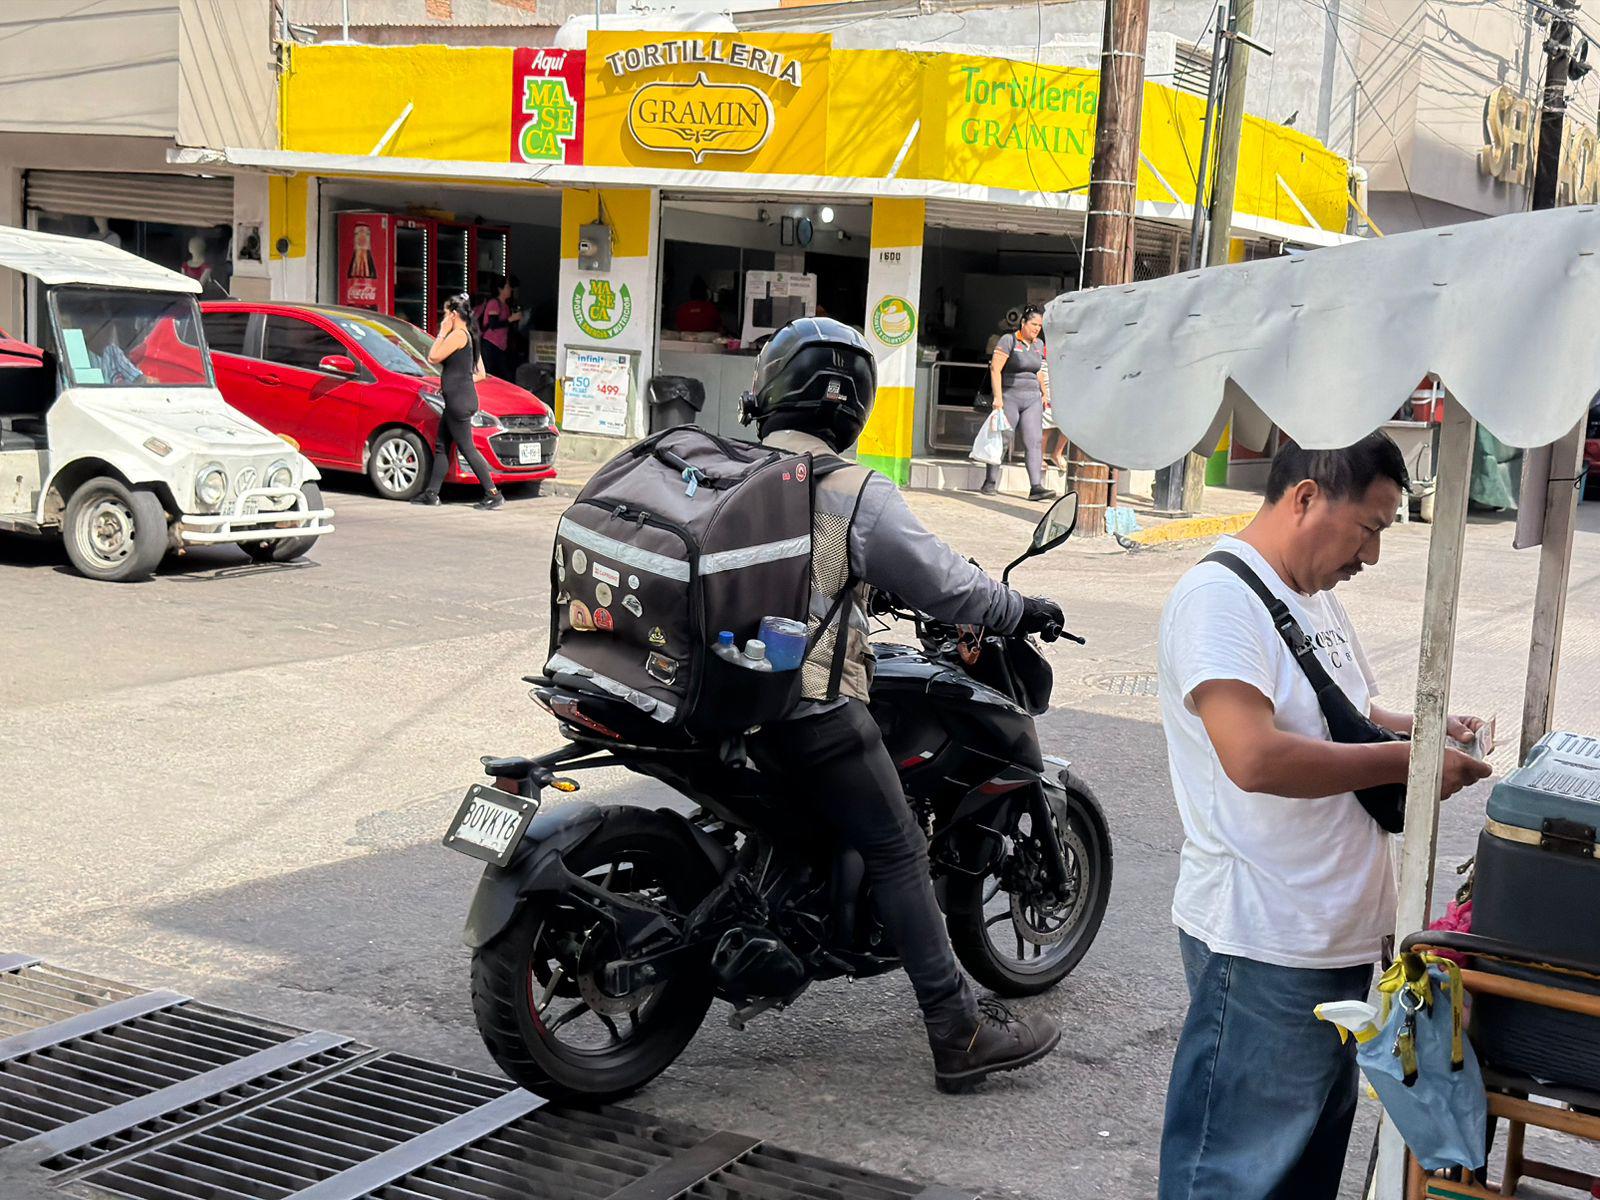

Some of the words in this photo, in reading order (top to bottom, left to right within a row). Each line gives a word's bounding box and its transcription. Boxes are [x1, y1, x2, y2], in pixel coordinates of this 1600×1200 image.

[605, 40, 801, 85] TORTILLERIA
[638, 98, 760, 128] GRAMIN
[960, 117, 1089, 156] GRAMIN
[879, 251, 901, 262] 1600
